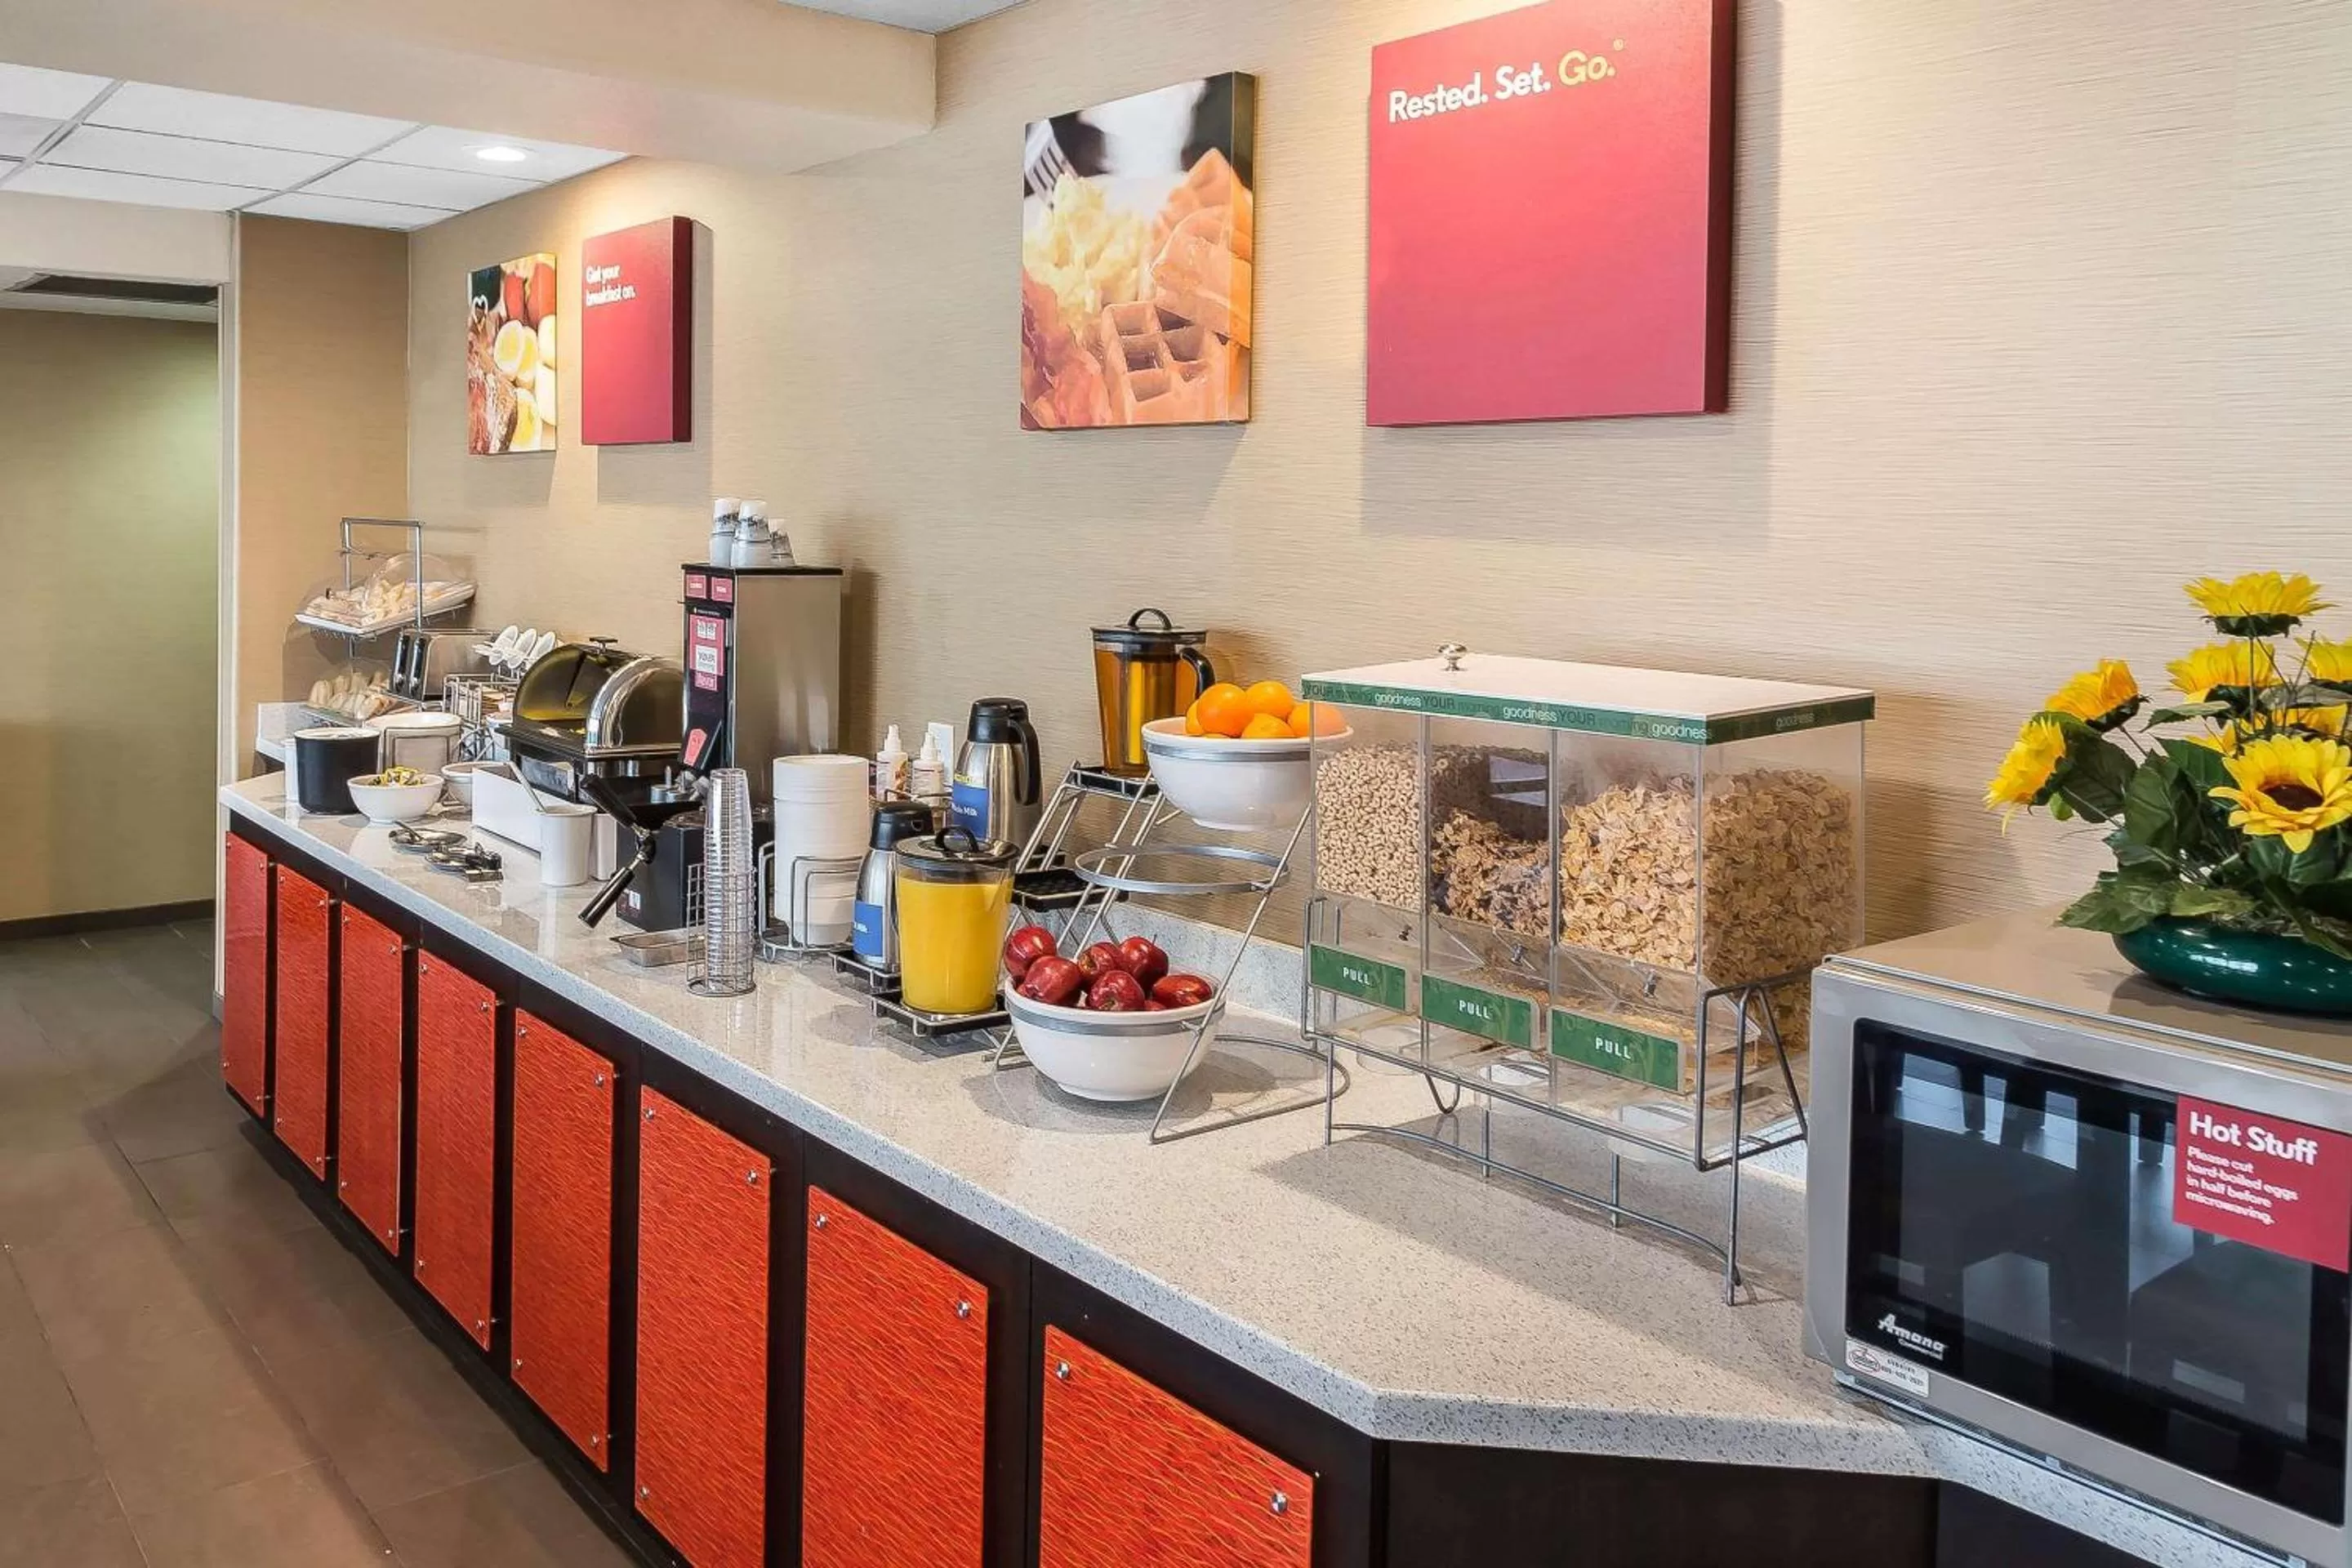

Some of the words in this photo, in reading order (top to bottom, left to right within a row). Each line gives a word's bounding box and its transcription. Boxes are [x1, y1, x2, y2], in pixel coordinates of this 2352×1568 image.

[1389, 71, 1489, 122] Rested.
[1494, 62, 1552, 100] Set.
[1374, 692, 1422, 708] goodness
[1423, 695, 1454, 709] YOUR
[1503, 706, 1557, 722] goodness
[1557, 710, 1595, 725] YOUR
[1343, 966, 1372, 987] PULL
[1459, 1000, 1490, 1020] PULL
[1595, 1036, 1632, 1060] PULL
[2189, 1111, 2241, 1147] Hot
[2247, 1126, 2318, 1165] Stuff
[2187, 1160, 2262, 1190] hard-boiled
[2188, 1146, 2230, 1168] Please
[2231, 1160, 2253, 1174] cut
[2185, 1191, 2276, 1225] microwaving.
[2186, 1175, 2199, 1188] in
[2201, 1178, 2225, 1194] half
[2227, 1186, 2273, 1209] before
[1878, 1313, 1946, 1352] Amana
